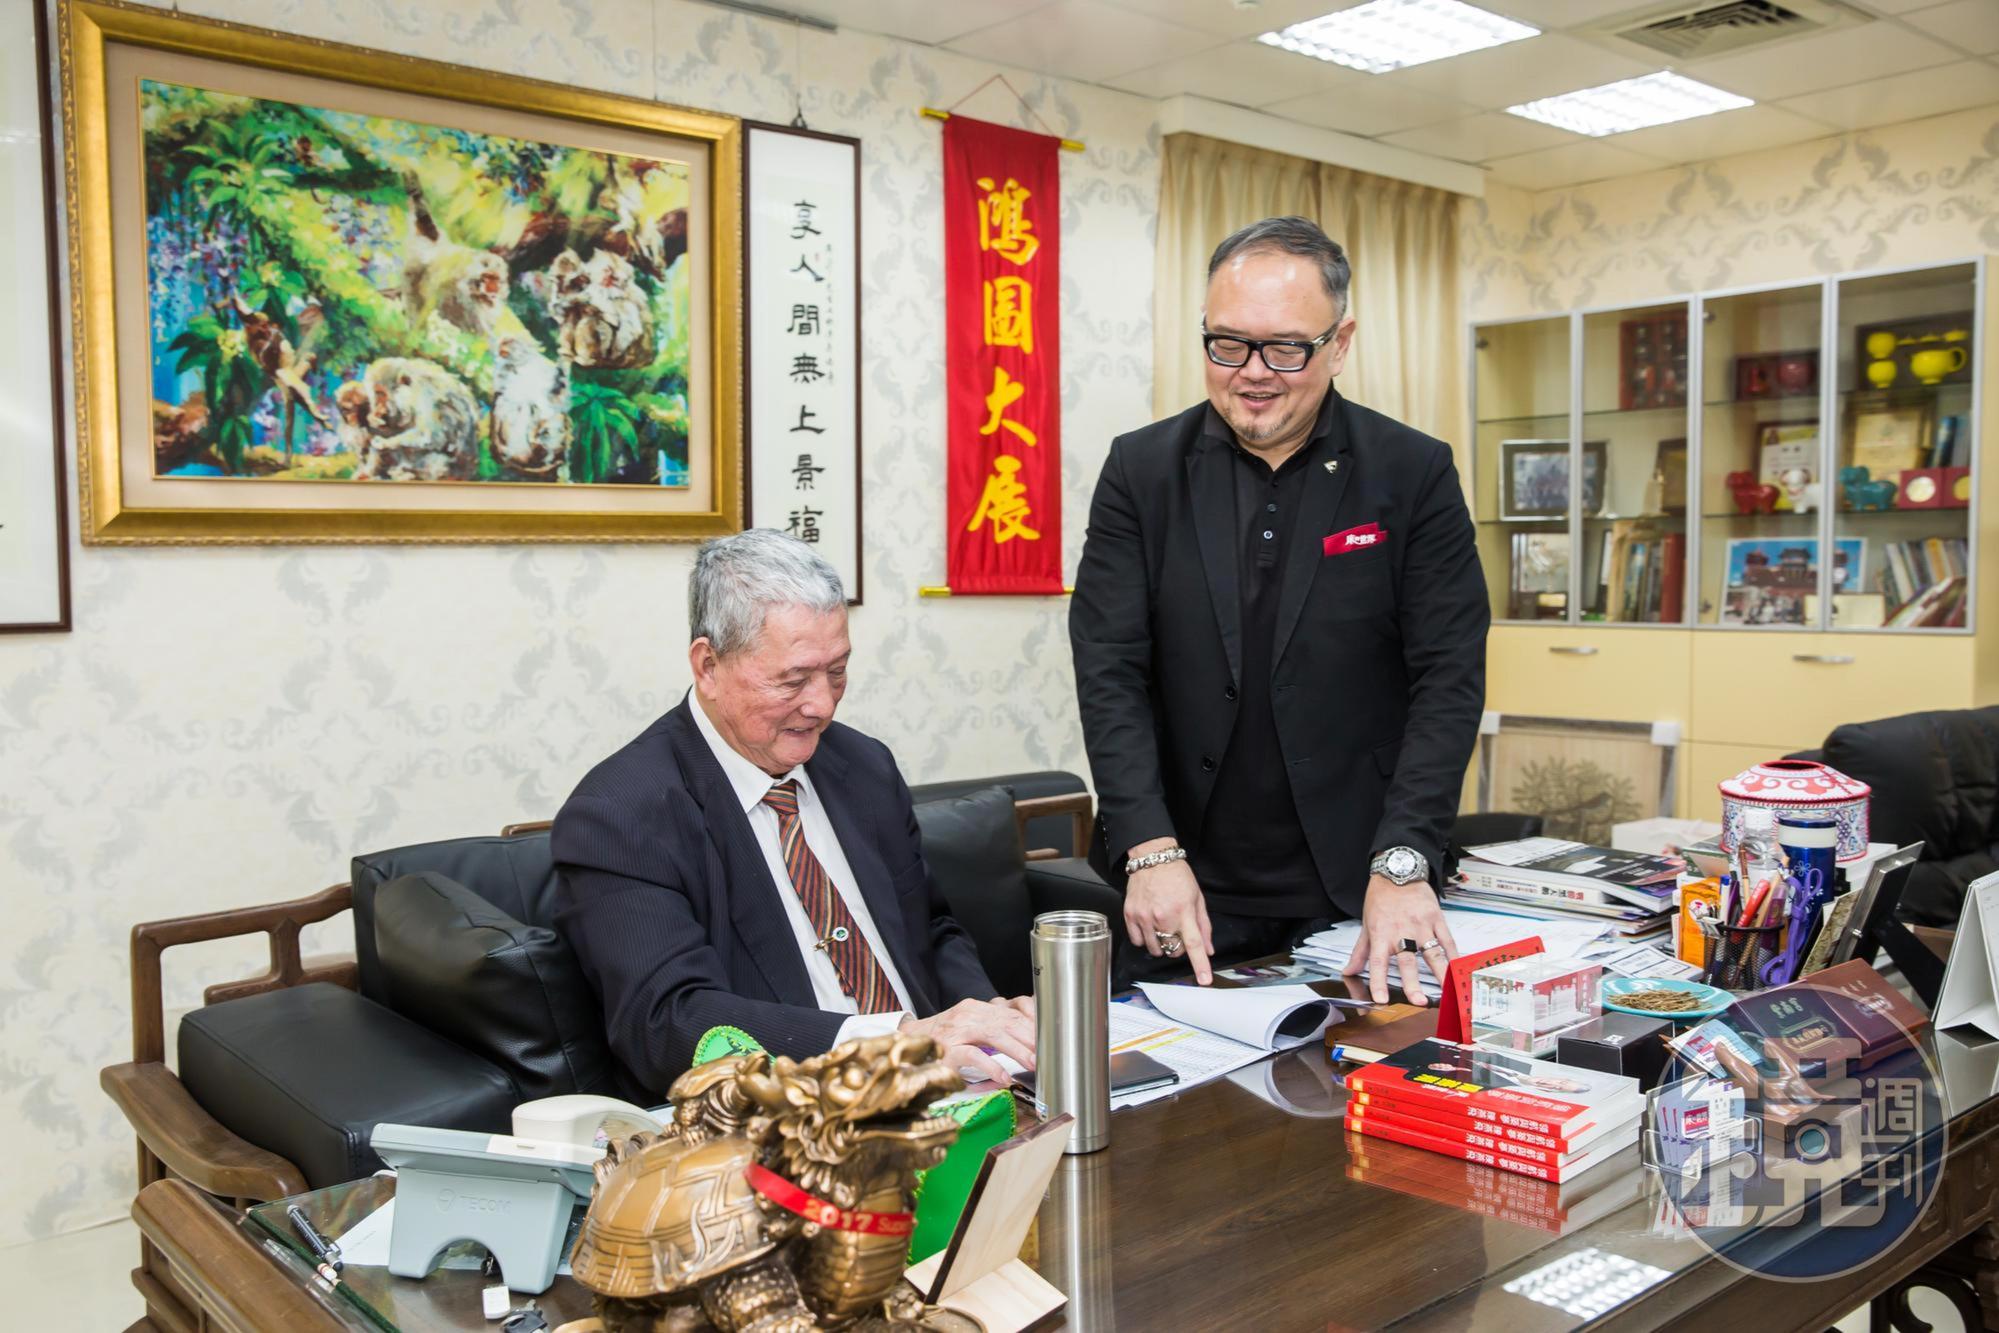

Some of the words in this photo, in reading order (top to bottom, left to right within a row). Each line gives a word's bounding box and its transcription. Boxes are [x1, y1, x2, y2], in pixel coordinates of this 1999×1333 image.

[966, 177, 1041, 545] 鴻圖大展
[803, 1198, 874, 1231] 2017
